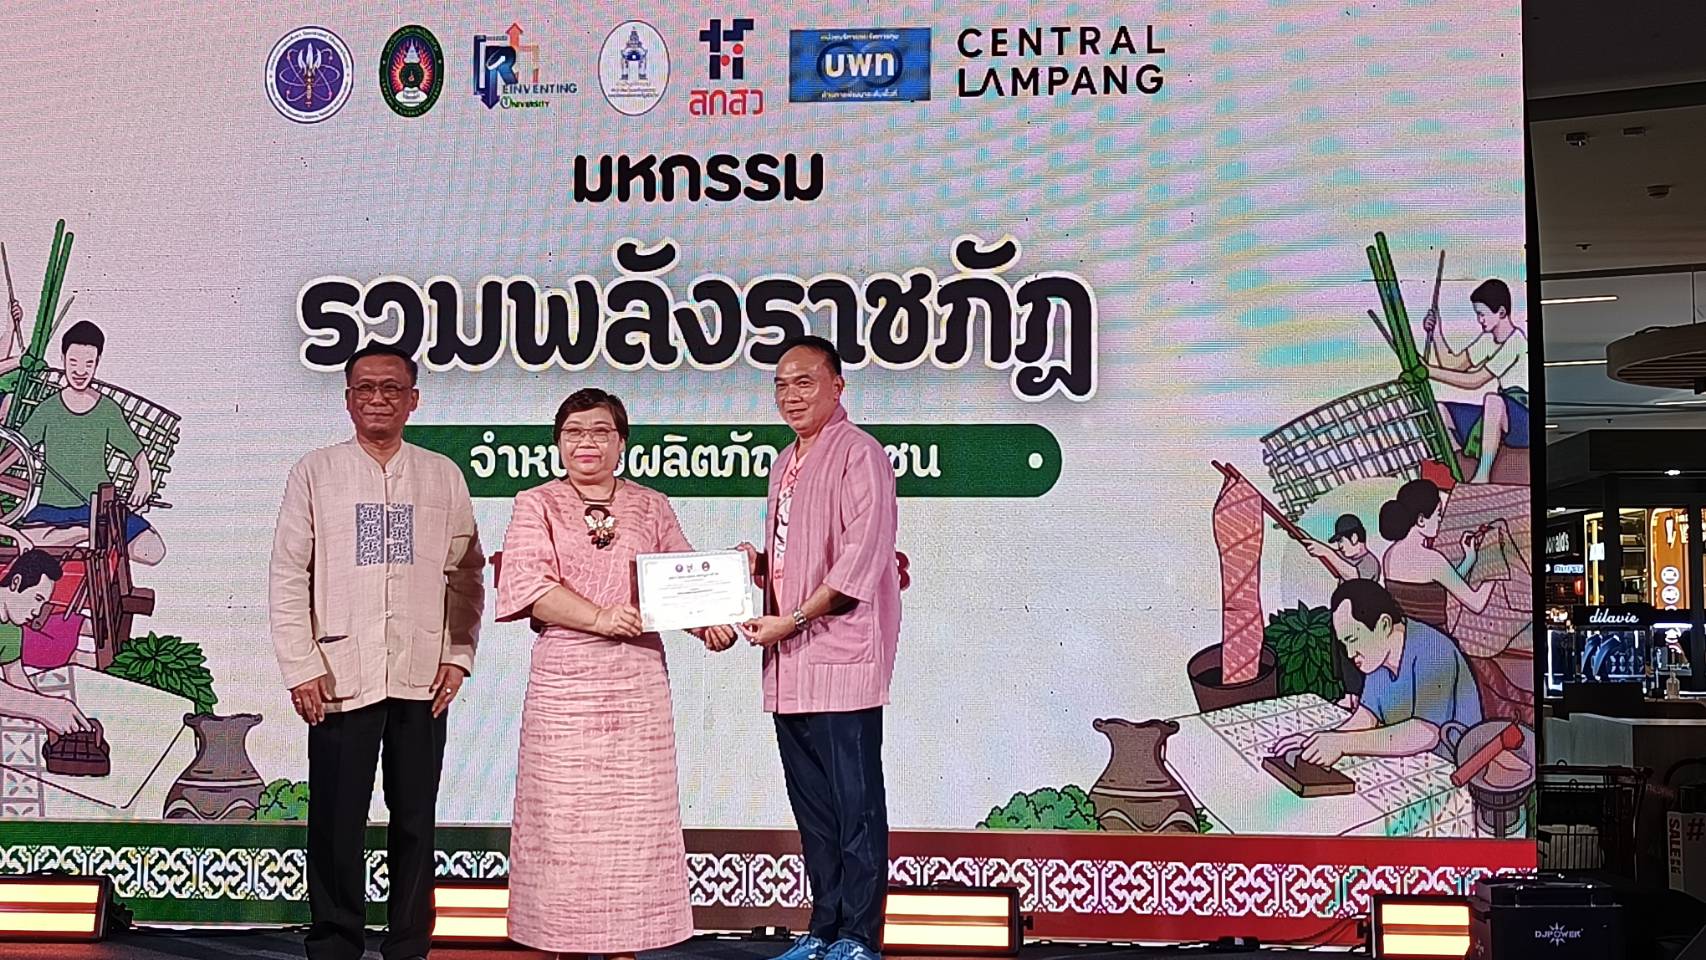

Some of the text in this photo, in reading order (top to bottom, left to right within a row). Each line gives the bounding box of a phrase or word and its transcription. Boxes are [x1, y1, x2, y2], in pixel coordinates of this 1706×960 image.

[959, 26, 1166, 59] CENTRAL
[824, 53, 896, 78] บพท
[959, 65, 1165, 98] LAMPANG
[690, 90, 765, 116] สกสว
[574, 154, 825, 204] มหกรรม
[301, 239, 1093, 398] รวมพลังราชภัฏ
[1589, 608, 1640, 624] dilavie
